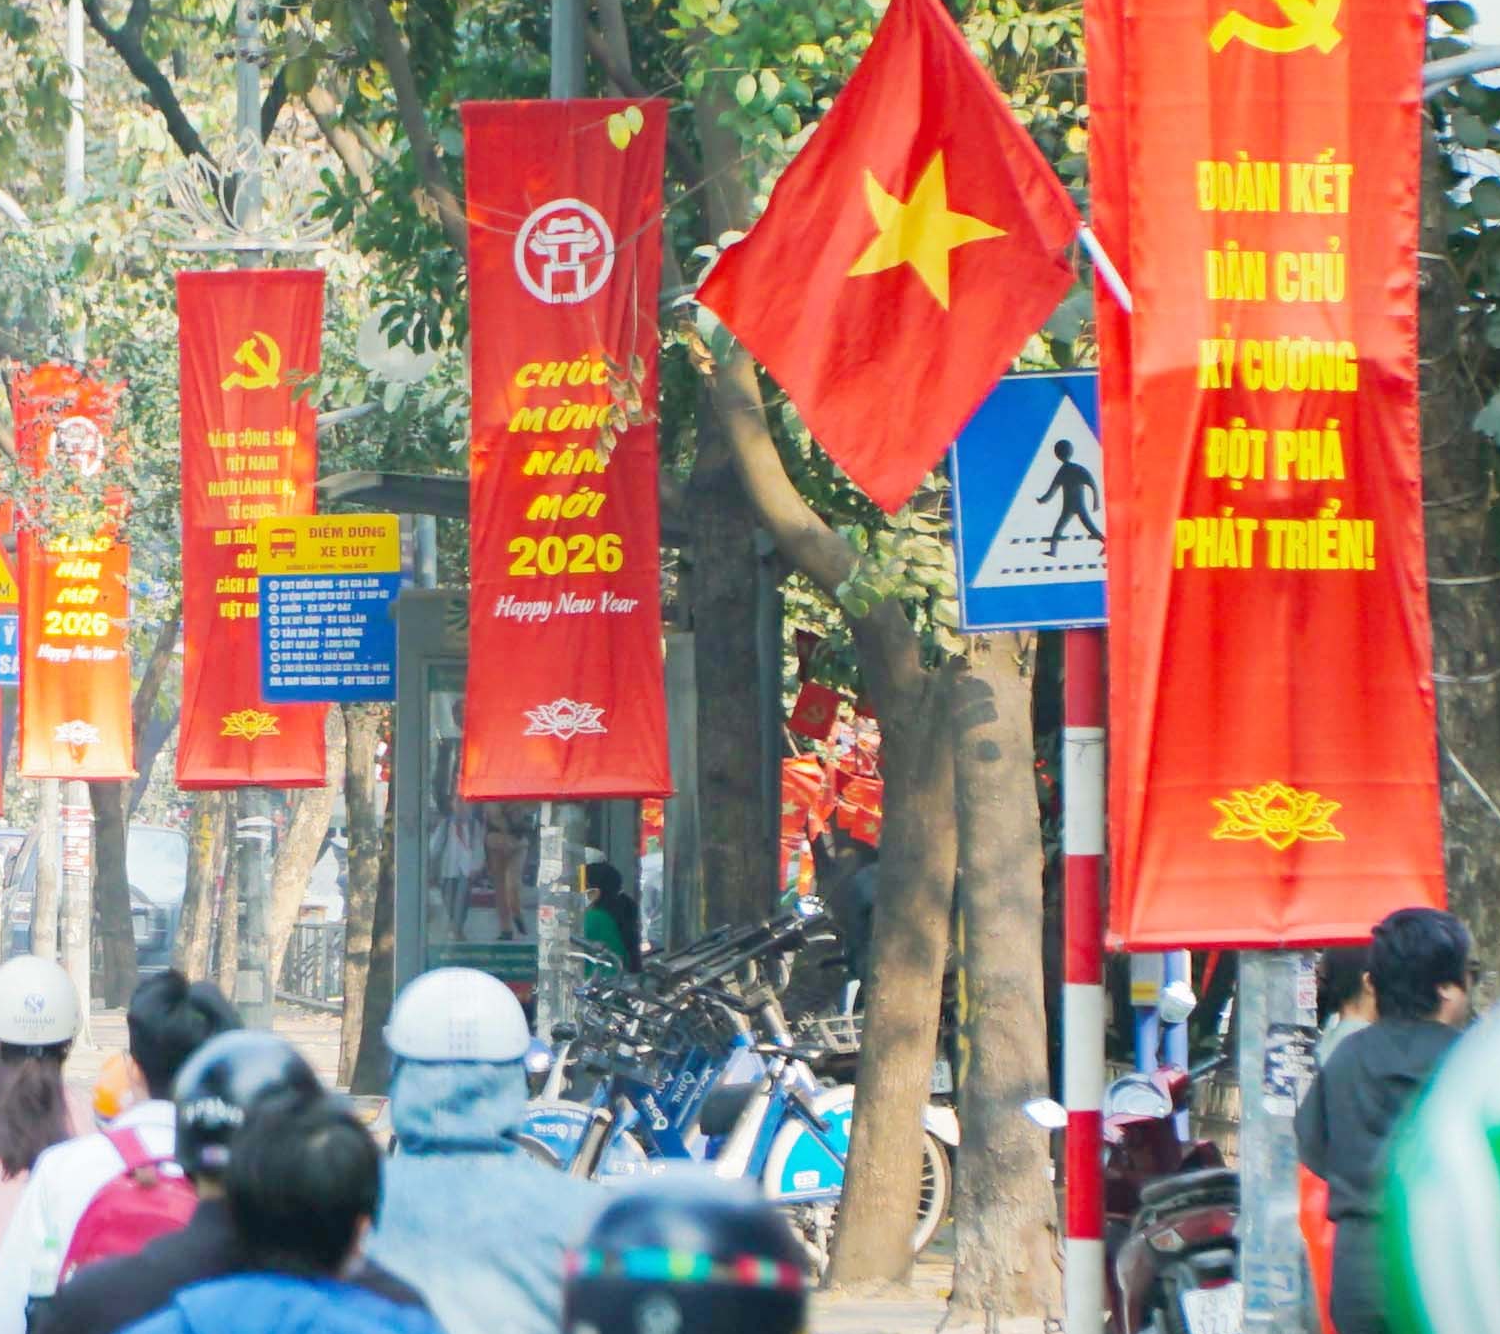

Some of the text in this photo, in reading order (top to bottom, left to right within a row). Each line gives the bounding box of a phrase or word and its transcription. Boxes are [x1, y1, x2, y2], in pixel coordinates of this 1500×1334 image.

[1196, 148, 1354, 214] ĐOÀN KẾT
[1205, 235, 1345, 302] DÂN CHỦ
[514, 355, 609, 389] CHÚC
[1198, 322, 1358, 392] KỶ CƯƠNG
[1206, 417, 1345, 491] ĐỘT PHÁ
[526, 486, 606, 522] MỚI
[321, 546, 337, 557] XE
[1175, 498, 1376, 570] PHÁT TRIỂN!
[508, 534, 624, 577] 2026
[216, 575, 245, 594] CÁCH
[44, 610, 110, 637] 2026
[220, 600, 243, 621] VIỆT
[494, 591, 639, 623] Happy New Year
[4, 620, 17, 646] Ý
